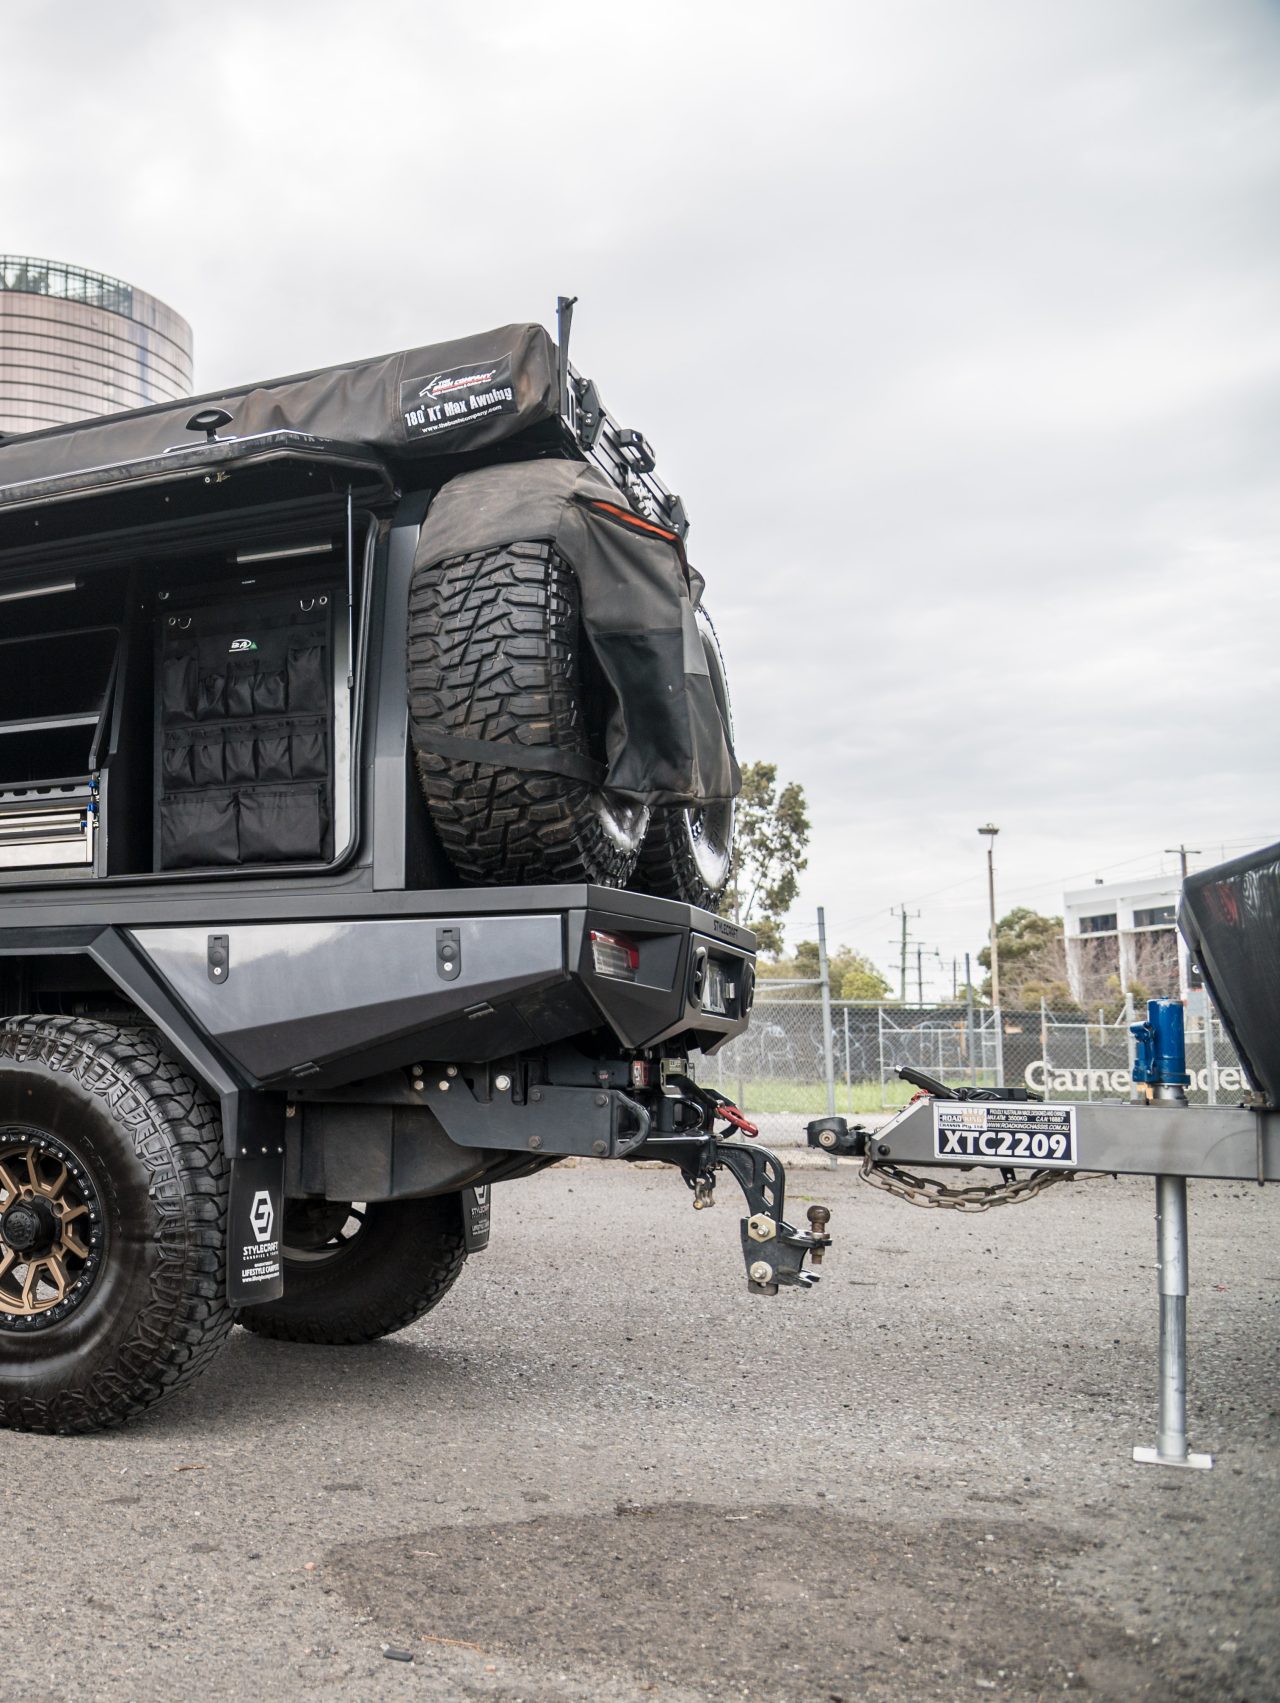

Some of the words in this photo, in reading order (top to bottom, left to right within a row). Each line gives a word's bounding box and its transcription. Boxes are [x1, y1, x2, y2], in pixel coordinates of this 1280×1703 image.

[427, 404, 441, 421] XT
[444, 401, 467, 417] Max
[469, 387, 512, 410] Awning
[943, 1130, 1067, 1158] XTC2209
[243, 1241, 278, 1256] STYLECRAFT
[242, 1266, 265, 1277] LIFESTYLE
